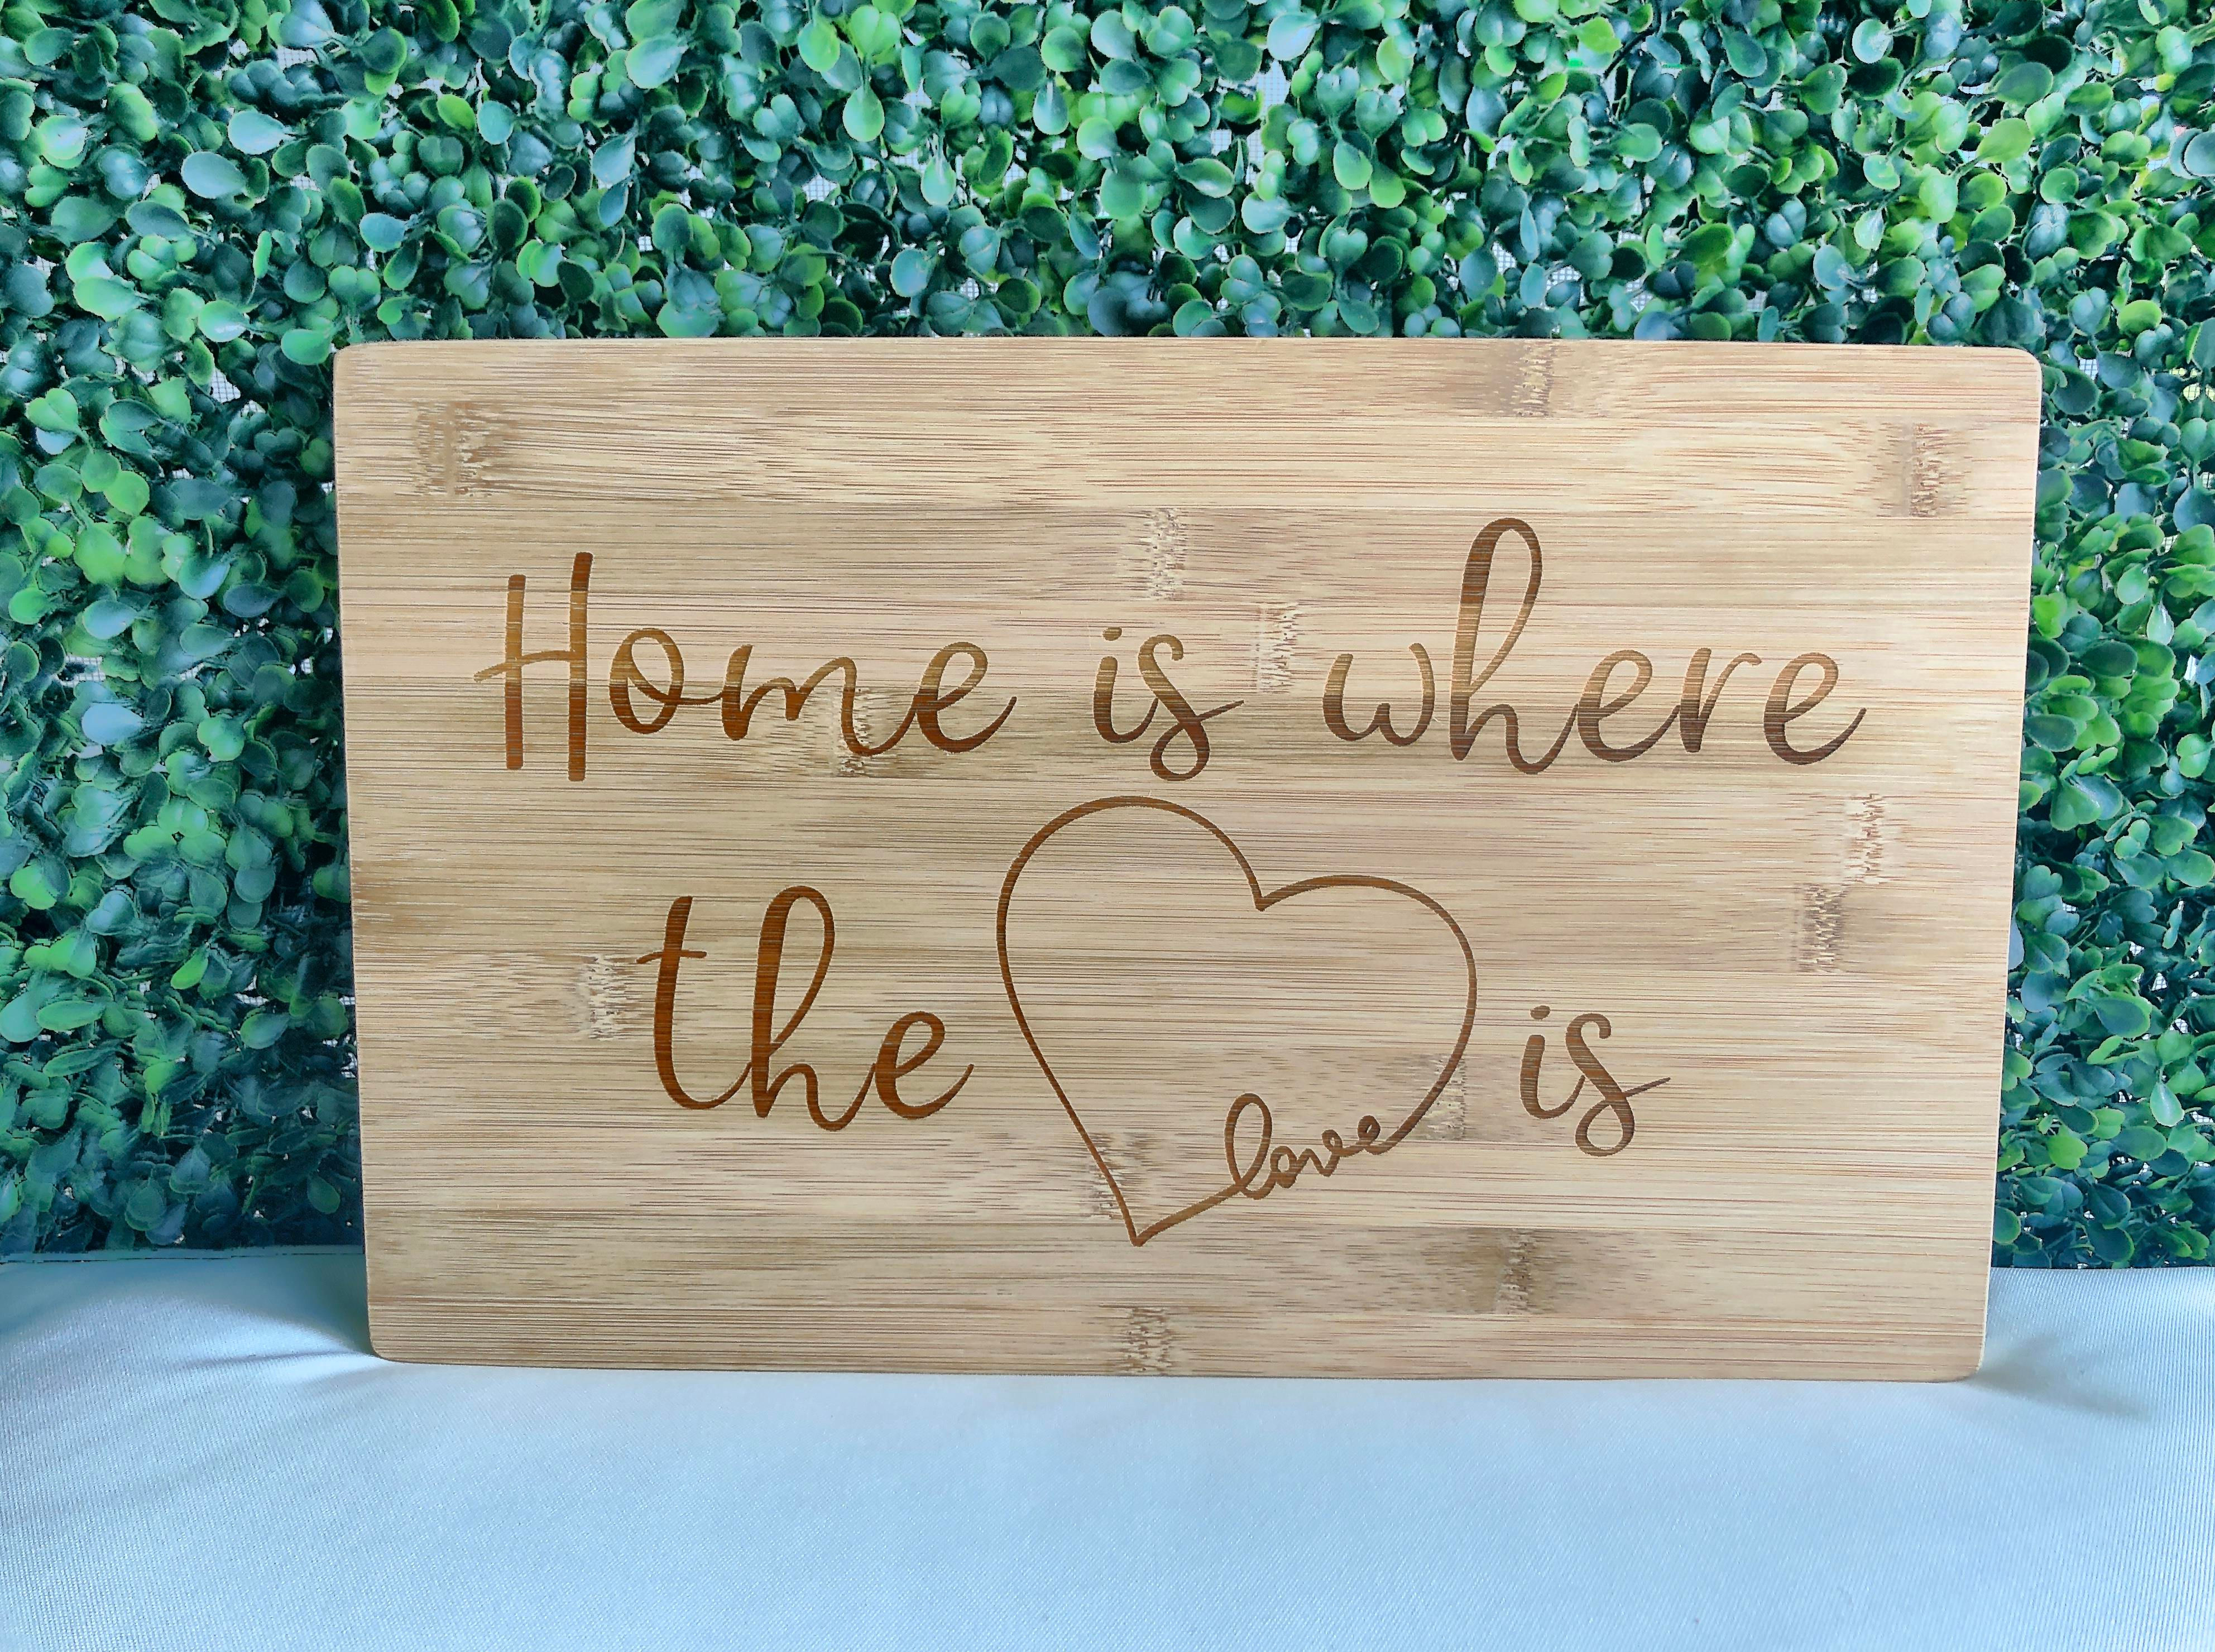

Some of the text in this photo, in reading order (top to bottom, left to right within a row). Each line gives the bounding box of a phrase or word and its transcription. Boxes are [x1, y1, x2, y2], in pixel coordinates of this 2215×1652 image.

[473, 518, 1867, 781] Home is where
[638, 886, 1670, 1156] the is
[1224, 1092, 1396, 1200] love
